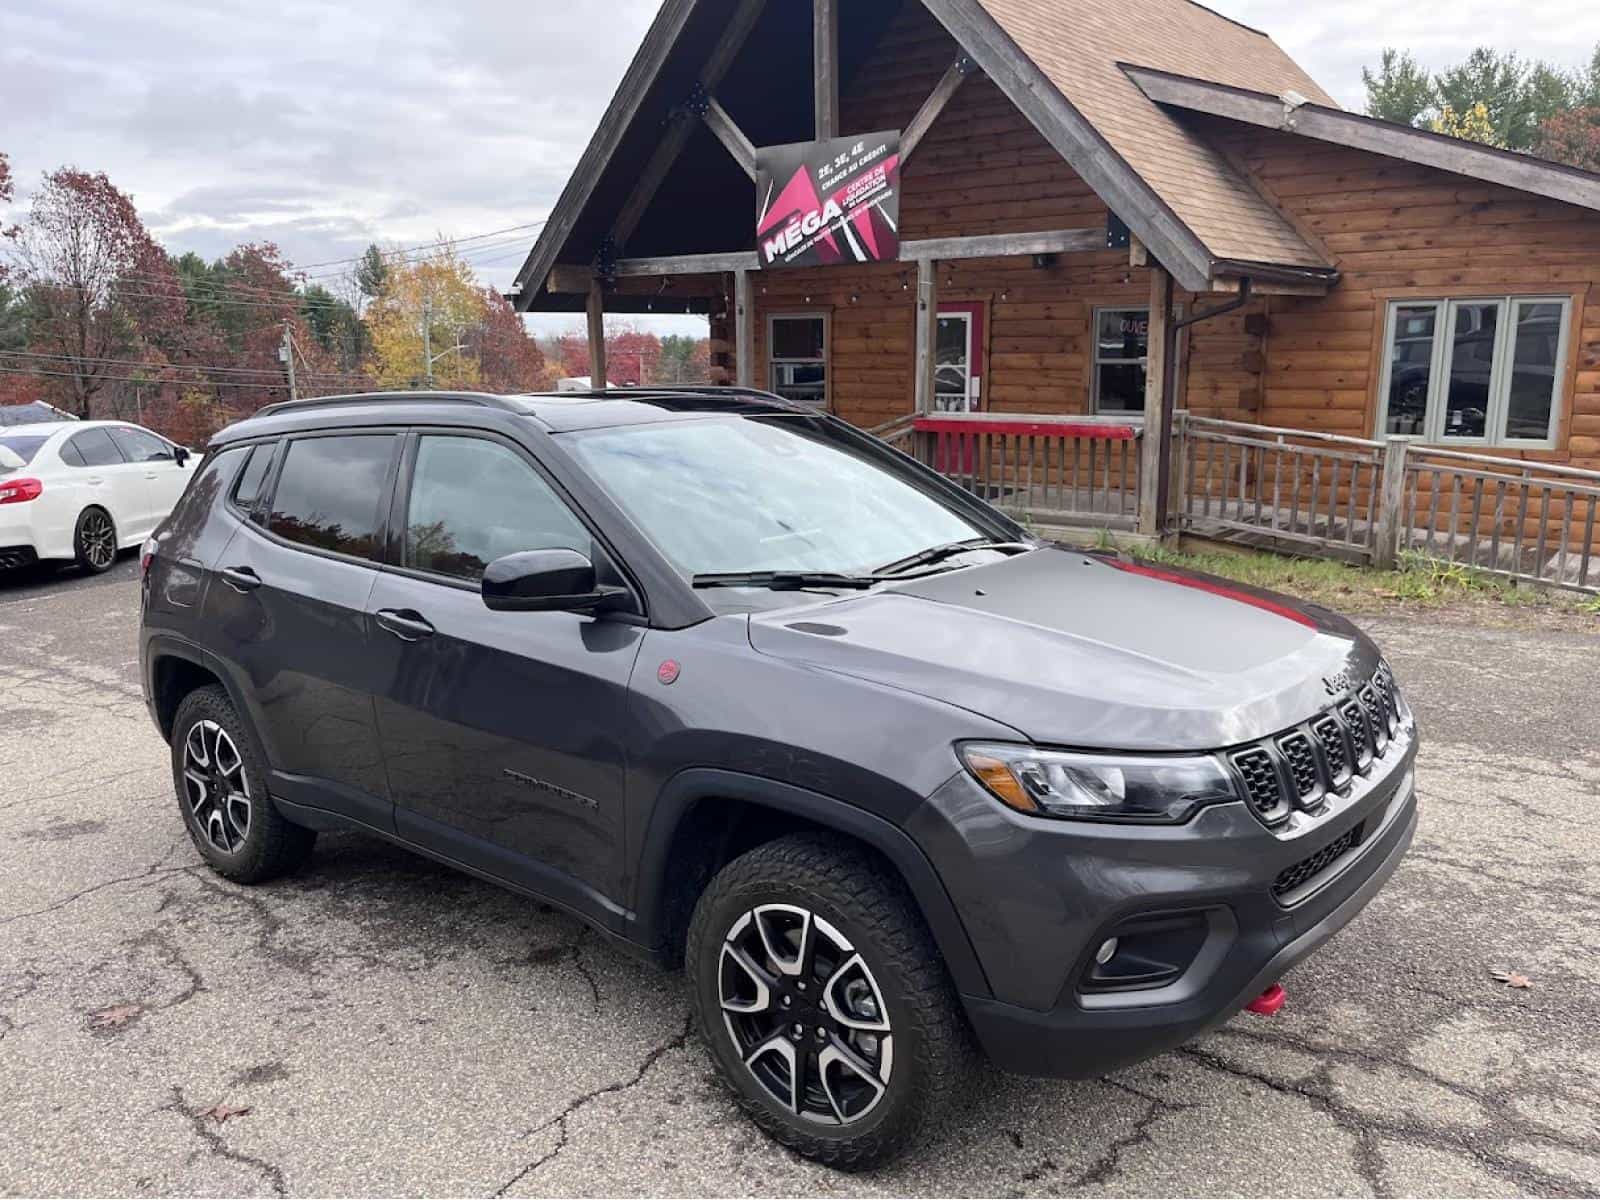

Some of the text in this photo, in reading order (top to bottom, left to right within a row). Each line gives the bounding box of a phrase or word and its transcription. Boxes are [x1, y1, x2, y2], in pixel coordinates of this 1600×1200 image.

[818, 141, 865, 180] 2E, 3E, 4E
[822, 169, 848, 191] CHANCE
[848, 161, 858, 174] AU
[847, 165, 886, 194] CENTRE DE
[764, 198, 843, 264] MÉGA
[1119, 319, 1148, 335] OUVE
